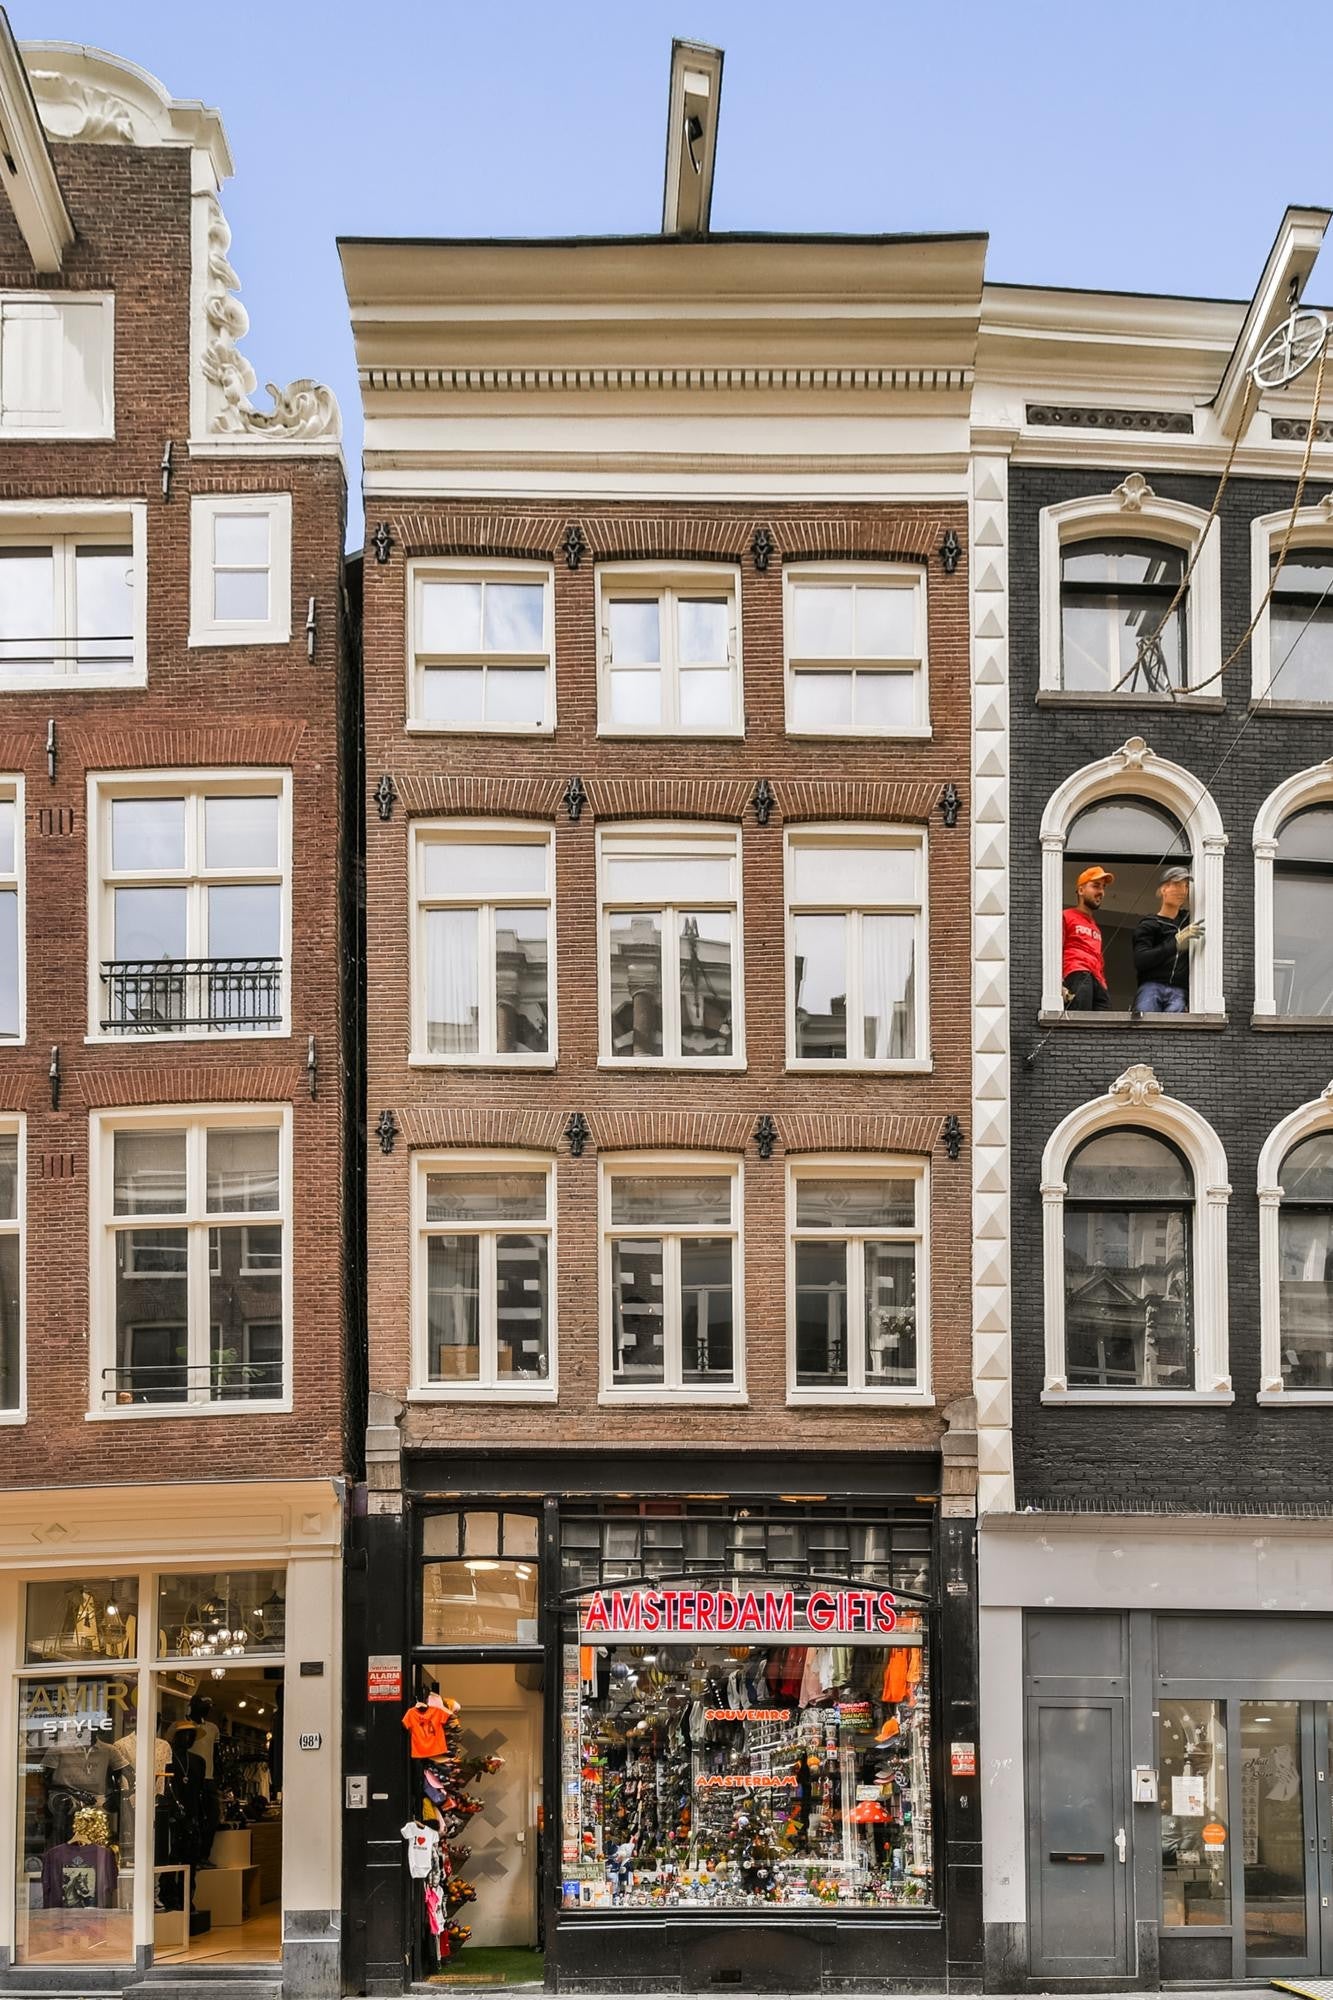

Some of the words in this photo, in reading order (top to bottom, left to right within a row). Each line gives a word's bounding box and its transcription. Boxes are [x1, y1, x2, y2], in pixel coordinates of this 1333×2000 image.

[585, 1590, 794, 1632] AMSTERDAM
[806, 1590, 897, 1632] GIFTS
[370, 1672, 400, 1680] ALARM
[704, 1709, 790, 1721] SOUVENIRS
[43, 1718, 113, 1733] STYLE
[695, 1775, 798, 1787] AMSTERDAM
